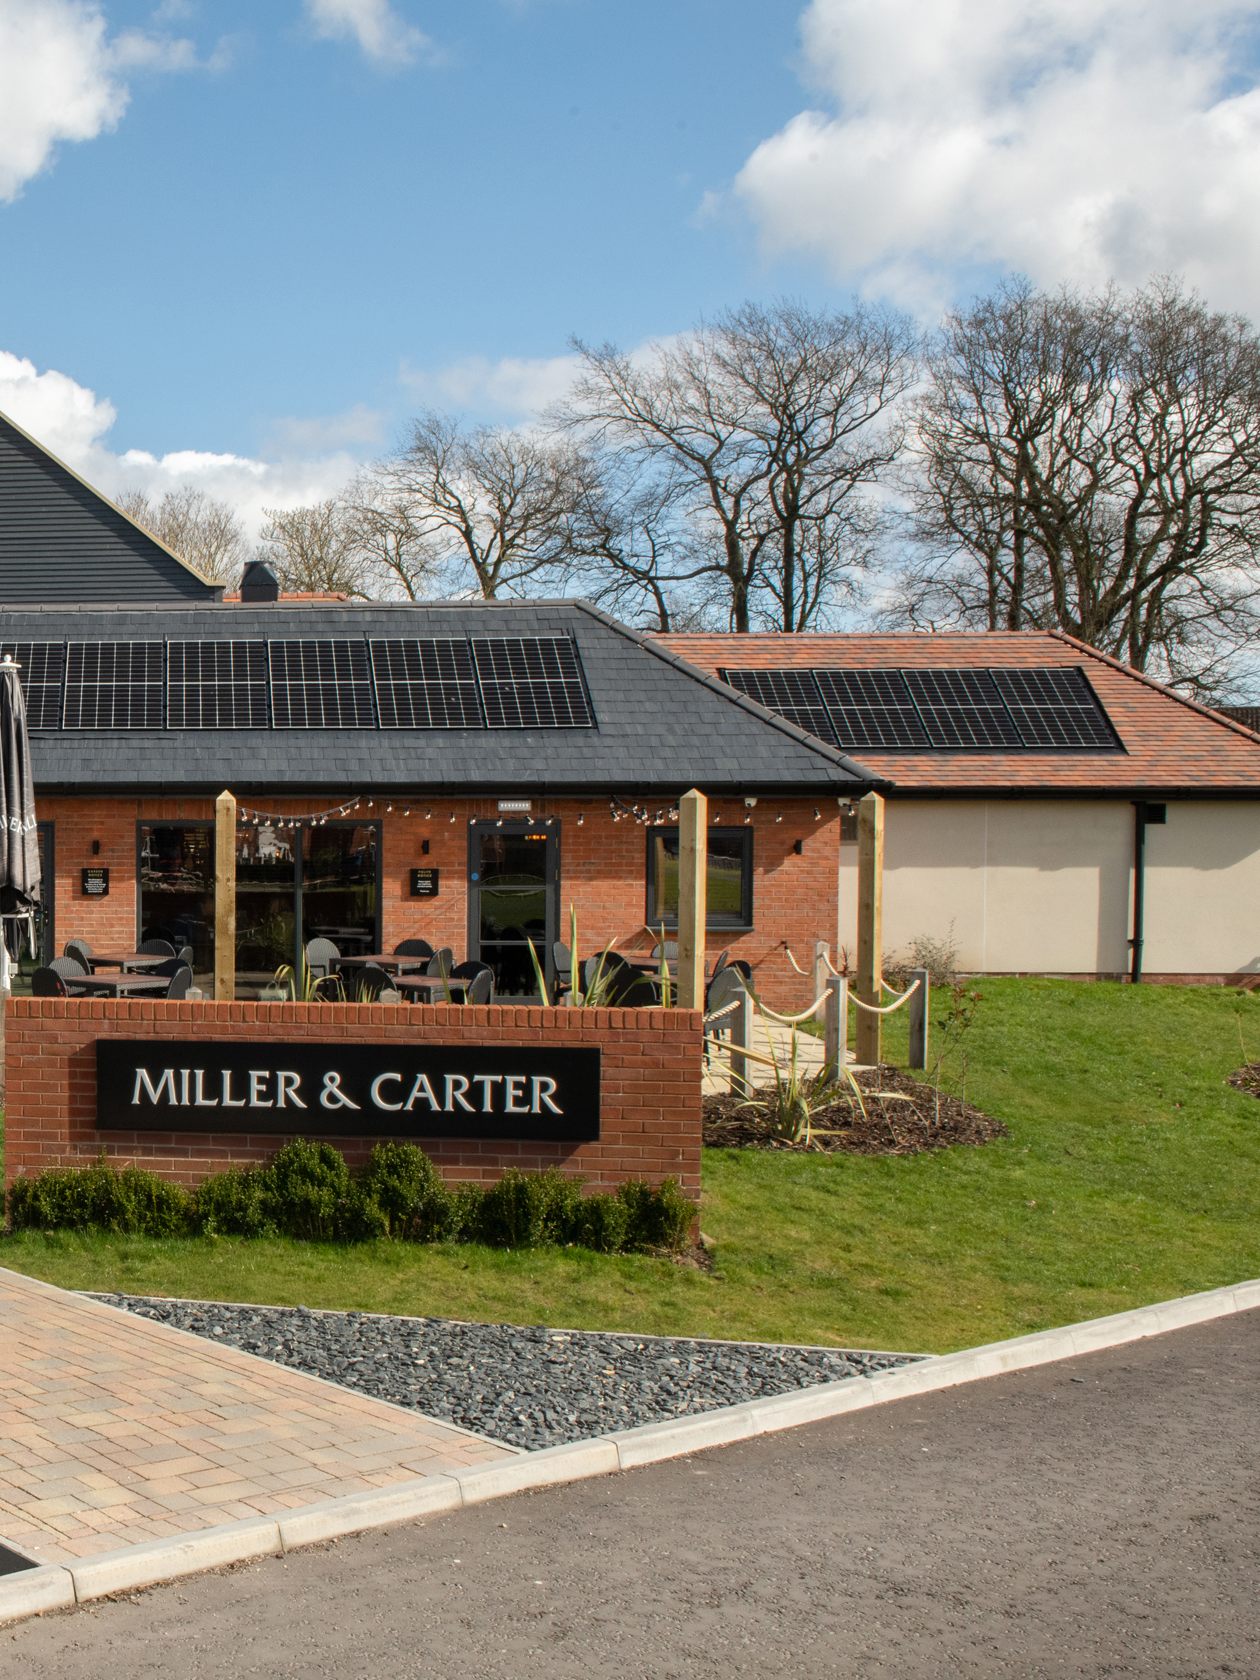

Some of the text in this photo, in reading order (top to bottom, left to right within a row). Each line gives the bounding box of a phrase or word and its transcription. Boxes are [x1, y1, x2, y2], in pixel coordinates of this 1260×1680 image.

[131, 1068, 564, 1114] MILLER & CARTER
